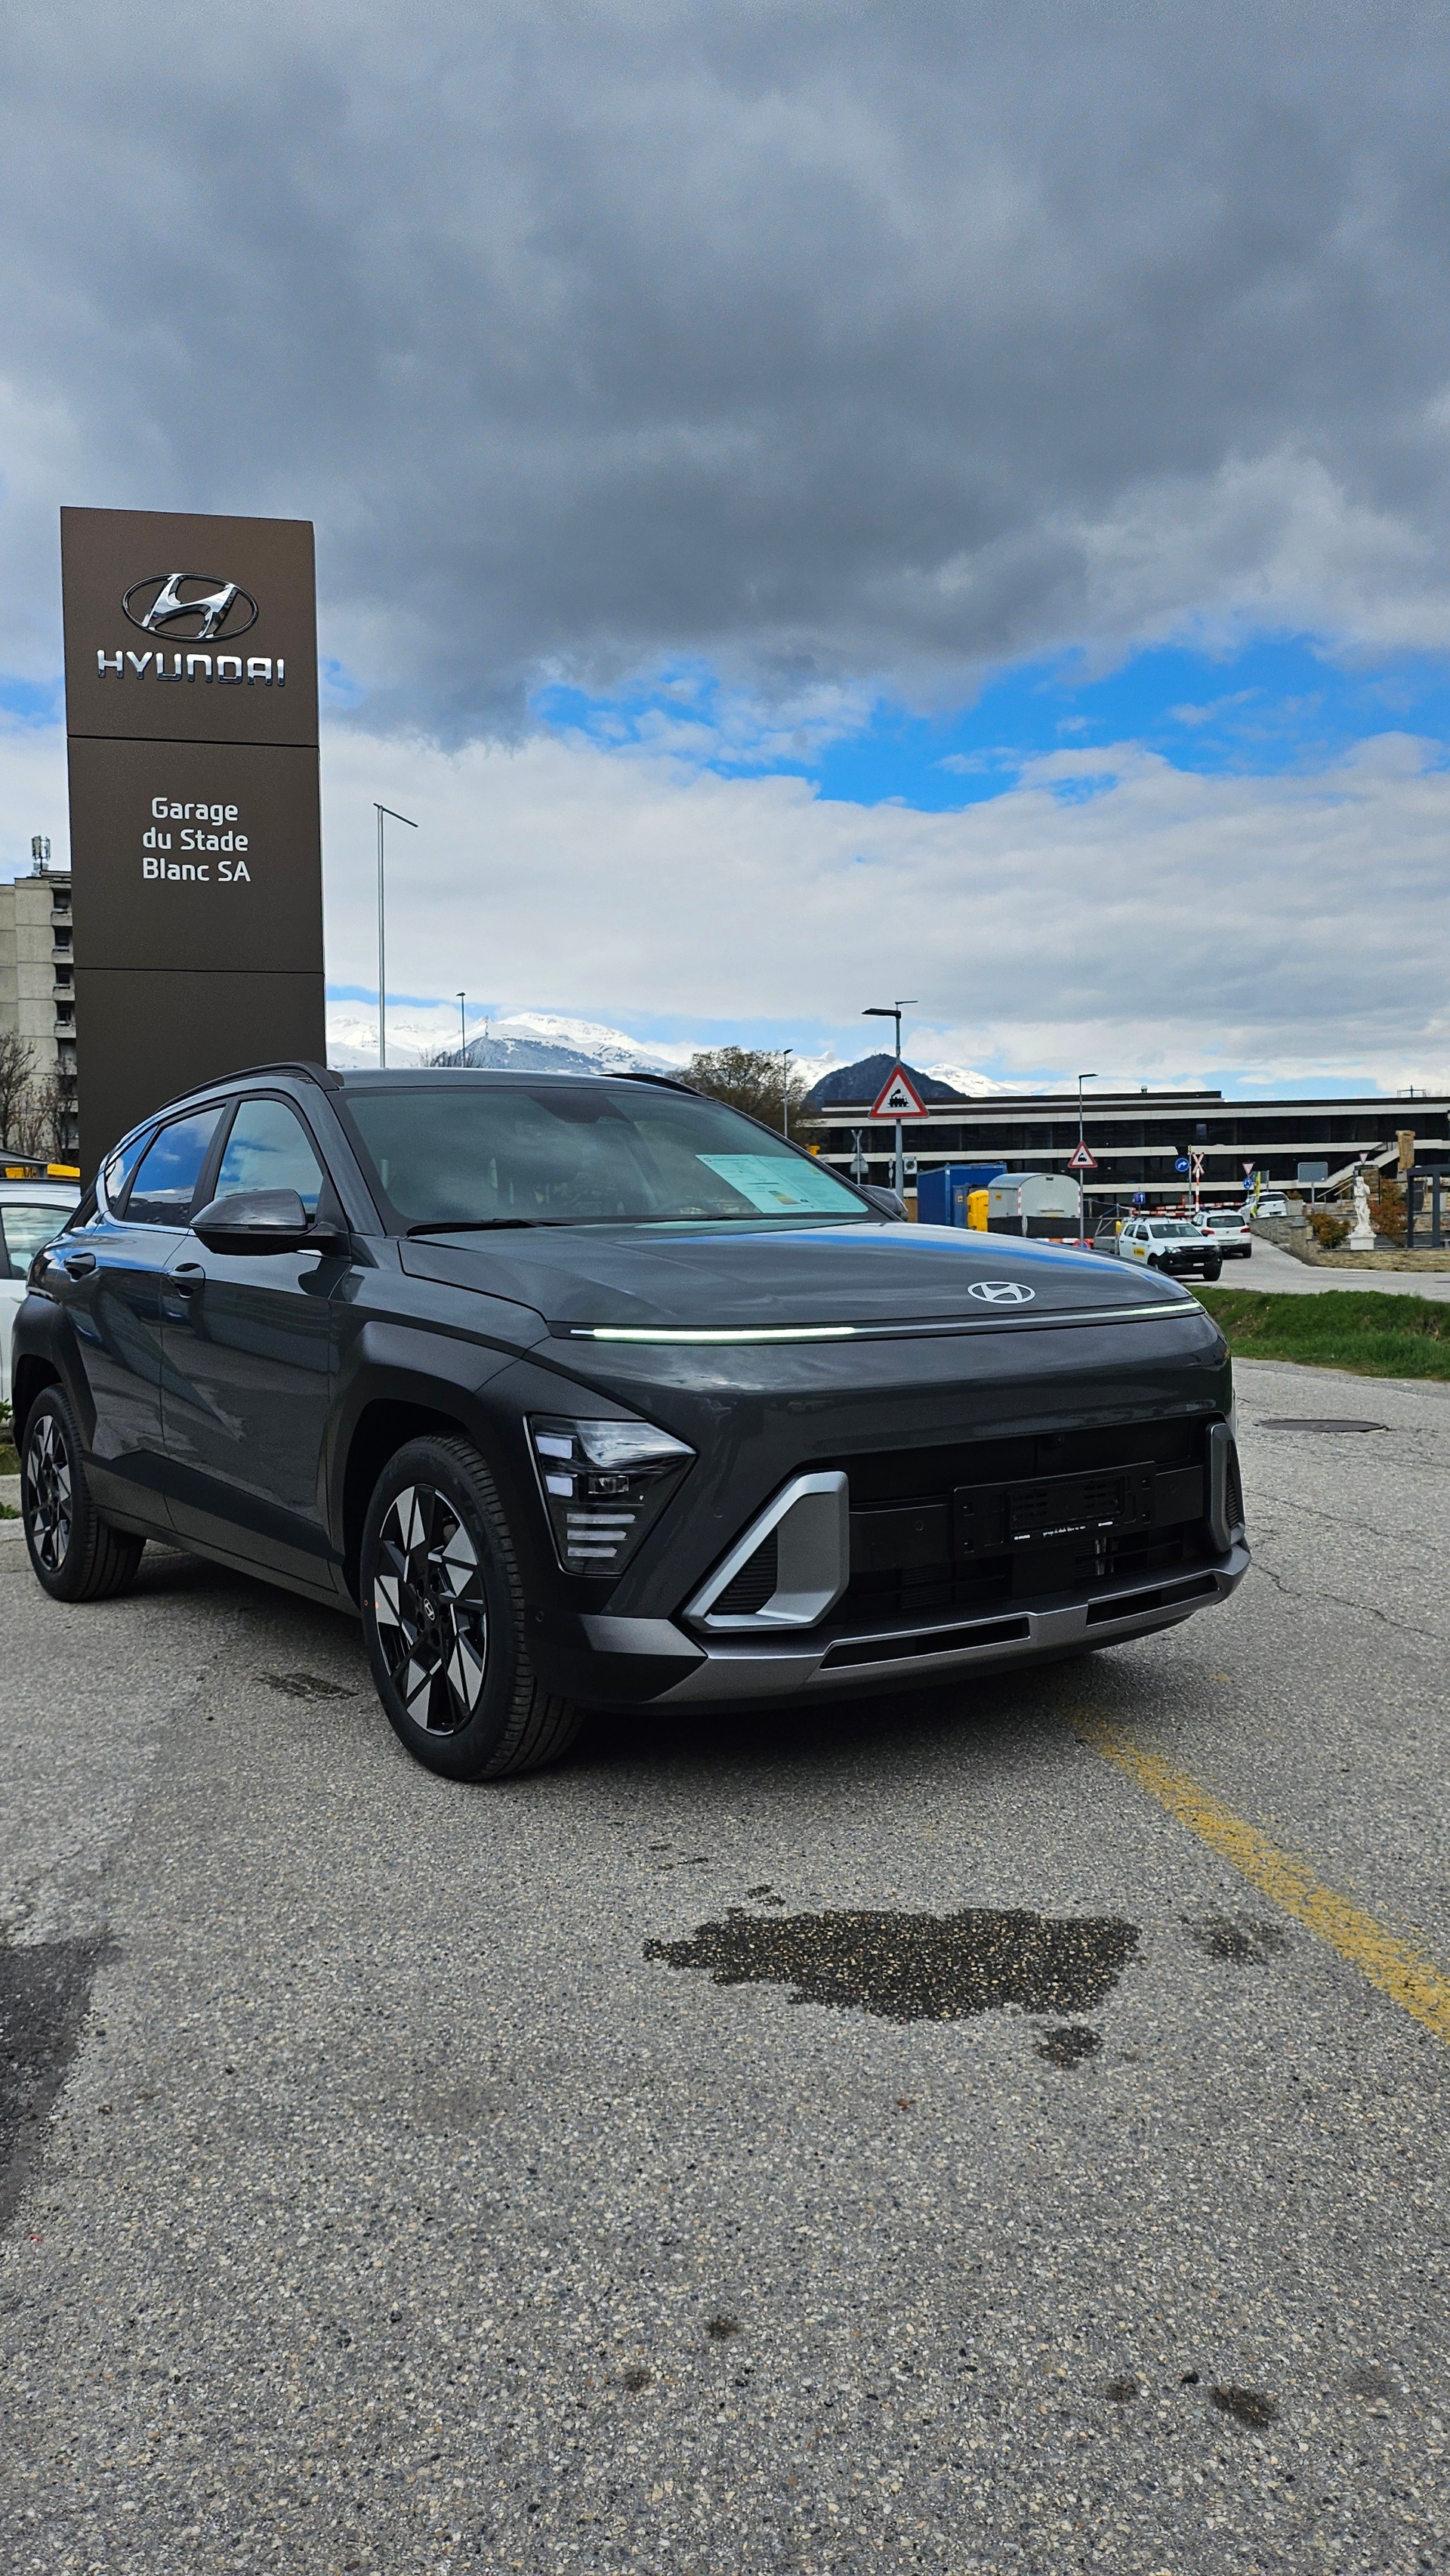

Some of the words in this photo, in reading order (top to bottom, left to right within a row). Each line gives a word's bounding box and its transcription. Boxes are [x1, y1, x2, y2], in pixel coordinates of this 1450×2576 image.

[97, 649, 286, 686] HYUNDAI
[152, 797, 239, 826] Garage
[142, 826, 172, 850] du
[180, 829, 249, 852] Stade
[143, 857, 211, 882] Blanc
[218, 860, 251, 883] SA
